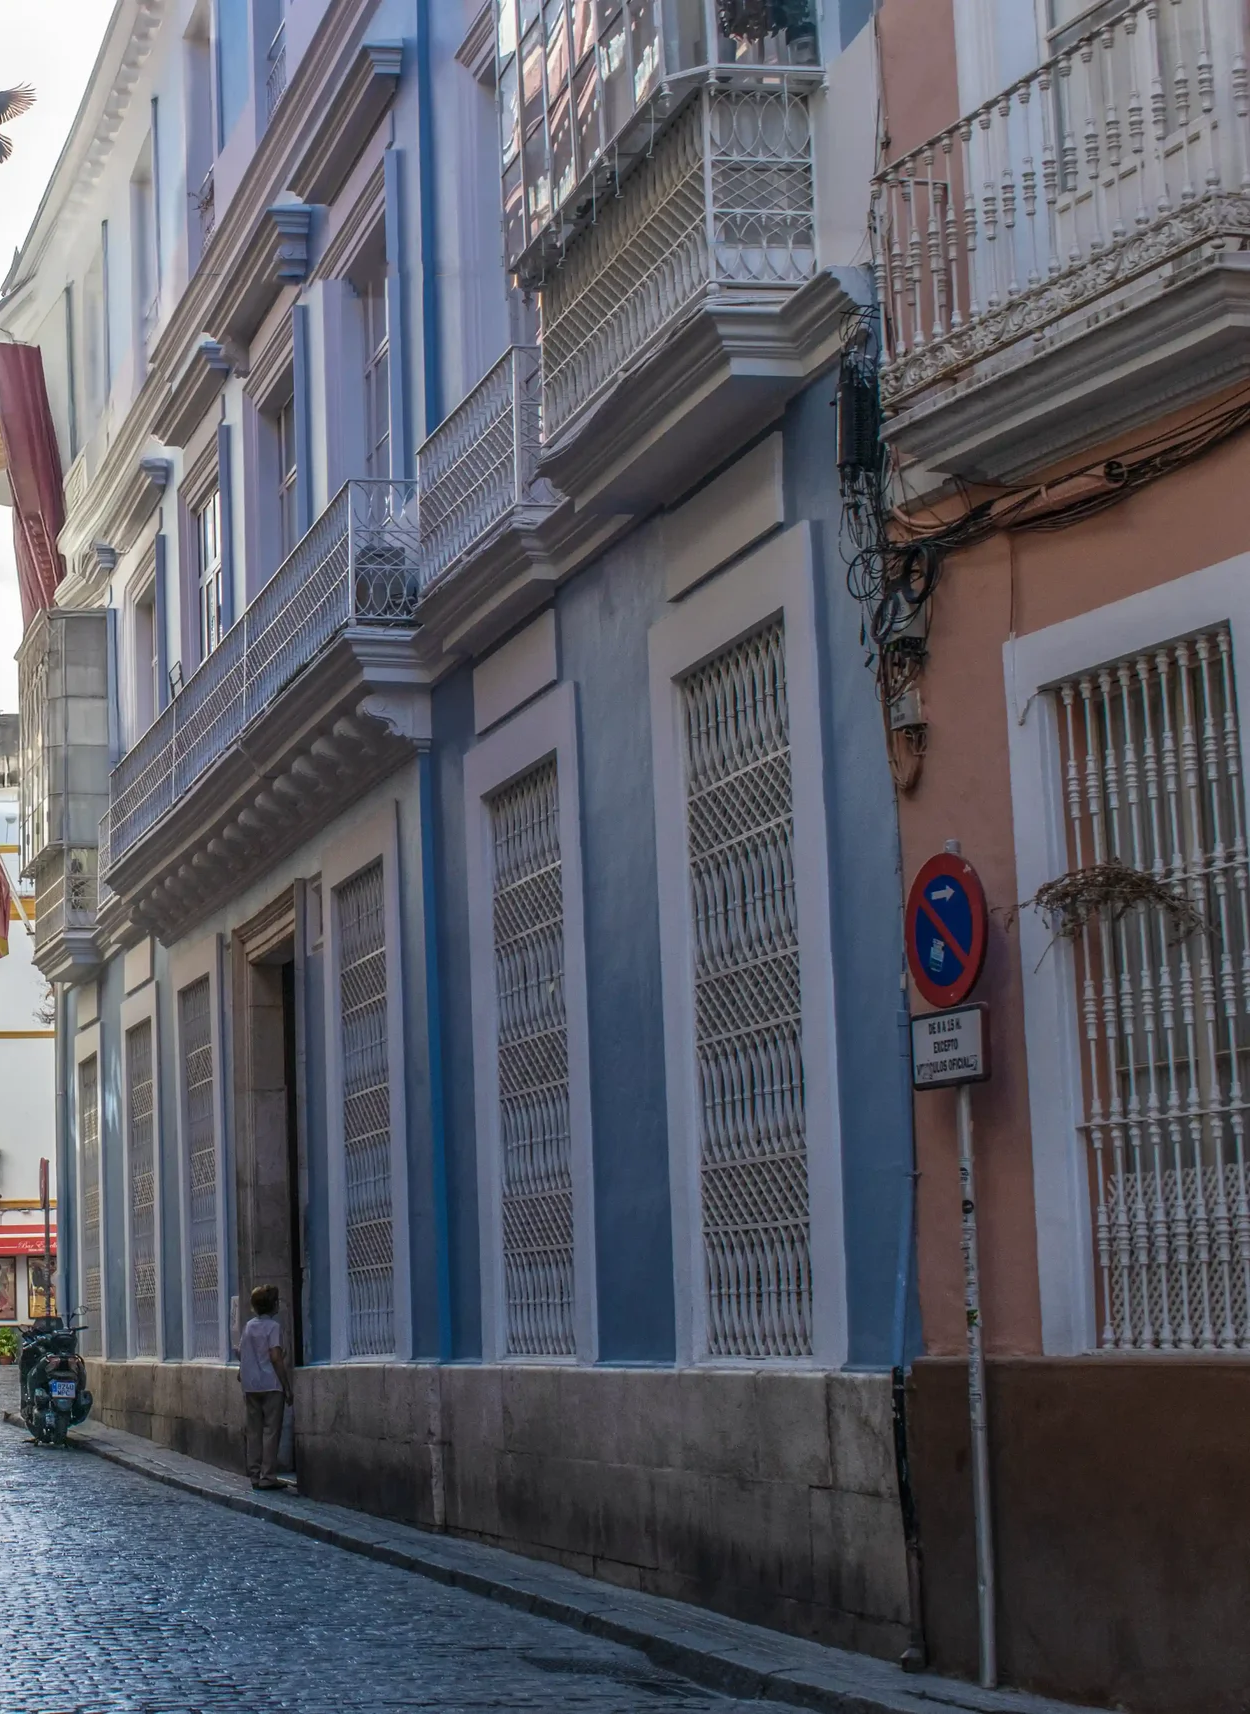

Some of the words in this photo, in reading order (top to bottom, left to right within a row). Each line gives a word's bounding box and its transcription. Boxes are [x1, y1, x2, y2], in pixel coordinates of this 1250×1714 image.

[928, 1022, 936, 1035] DE
[942, 1020, 946, 1032] A
[933, 1038, 958, 1054] EXCEPTO
